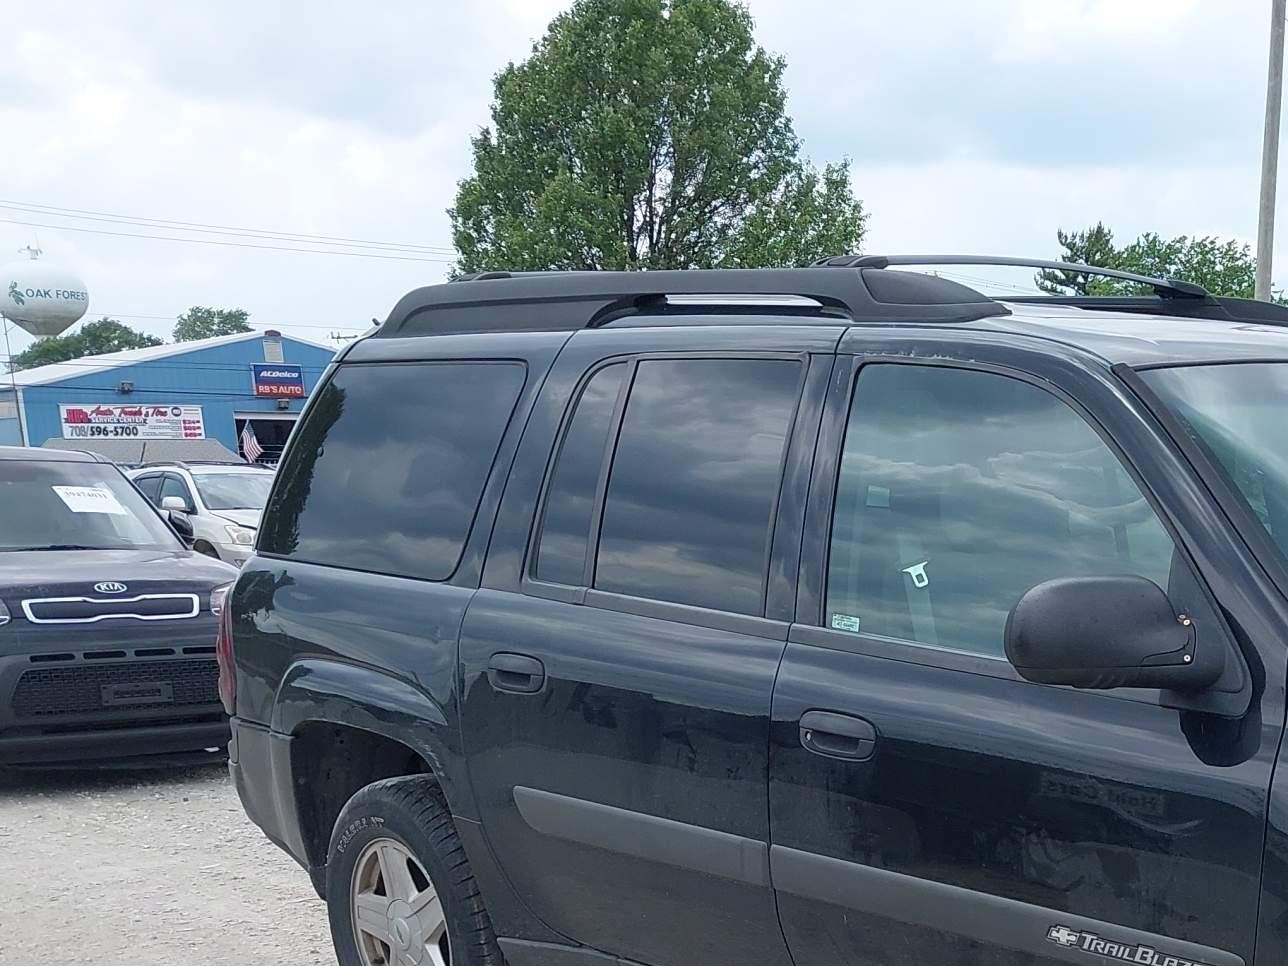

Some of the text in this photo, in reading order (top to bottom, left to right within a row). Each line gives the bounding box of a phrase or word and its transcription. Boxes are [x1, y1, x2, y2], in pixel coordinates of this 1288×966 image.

[25, 288, 52, 299] OAK
[260, 370, 299, 378] ACDelco
[258, 385, 302, 394] RB'S AUTO
[98, 583, 122, 592] KIA
